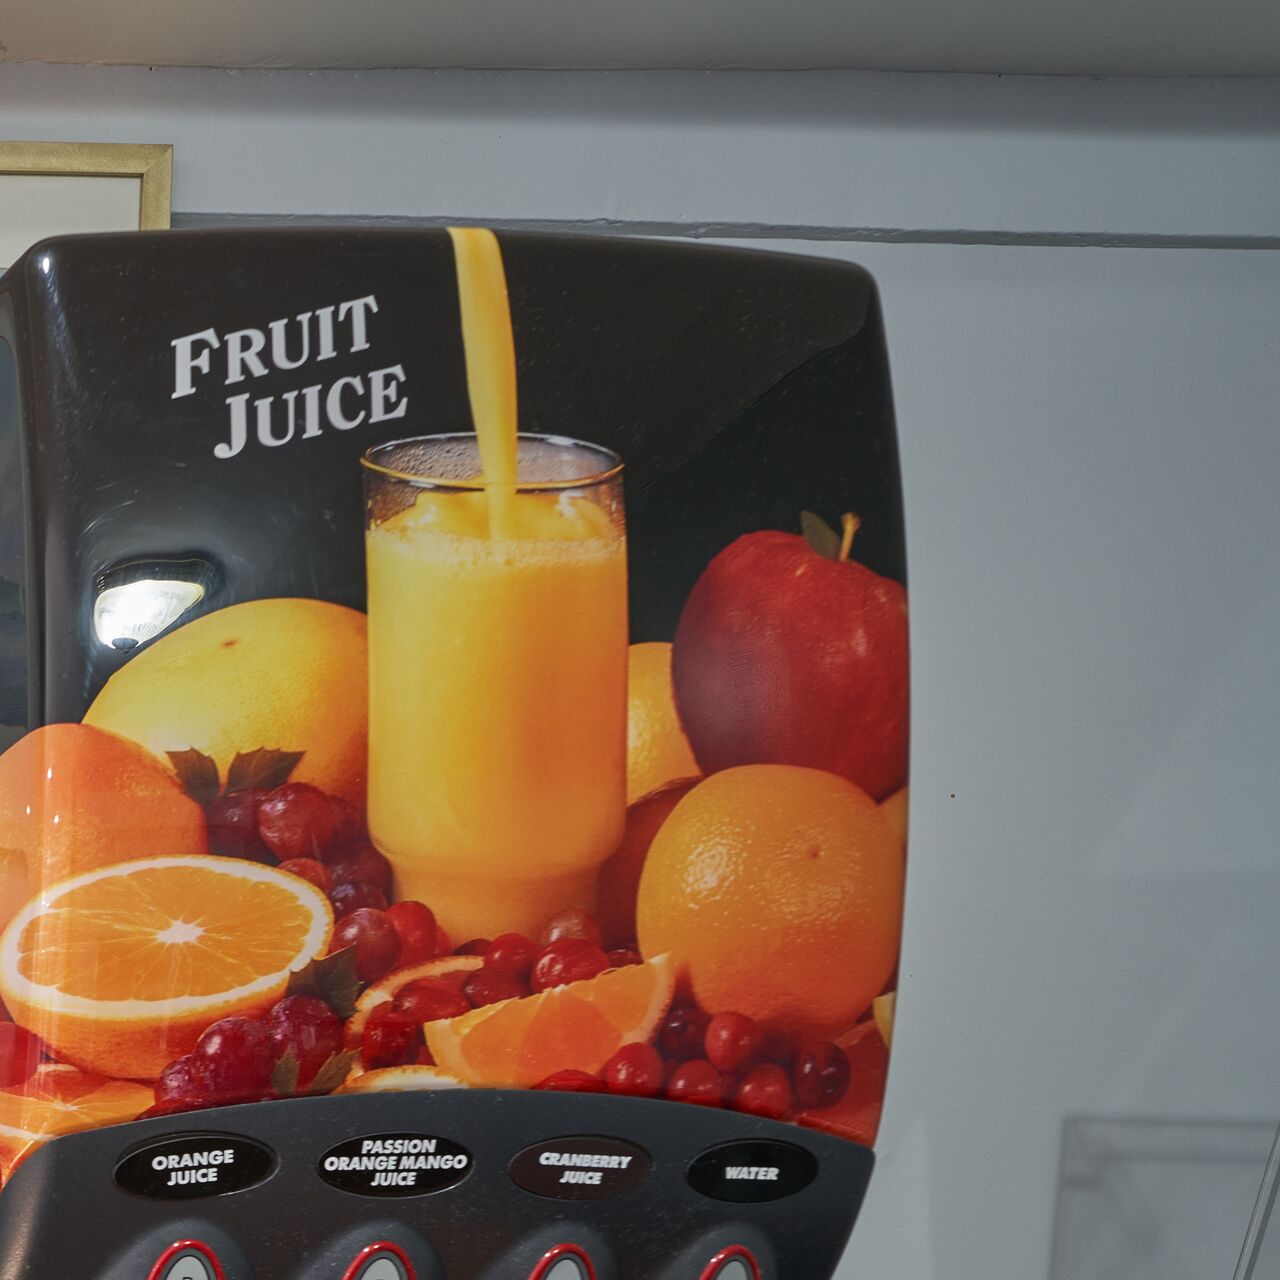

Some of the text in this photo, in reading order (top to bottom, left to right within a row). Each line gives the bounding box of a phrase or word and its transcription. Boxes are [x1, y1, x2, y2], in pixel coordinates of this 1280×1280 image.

[170, 294, 379, 399] FRUIT
[213, 364, 408, 459] JUICE
[361, 1139, 437, 1154] PASSION
[152, 1150, 235, 1171] ORANGE
[323, 1155, 468, 1171] ORANGE MANGO
[539, 1152, 632, 1169] CRANBERRY
[167, 1168, 218, 1186] JUICE
[370, 1172, 417, 1186] JUICE
[559, 1171, 603, 1185] JUICE
[725, 1166, 780, 1180] WATER
